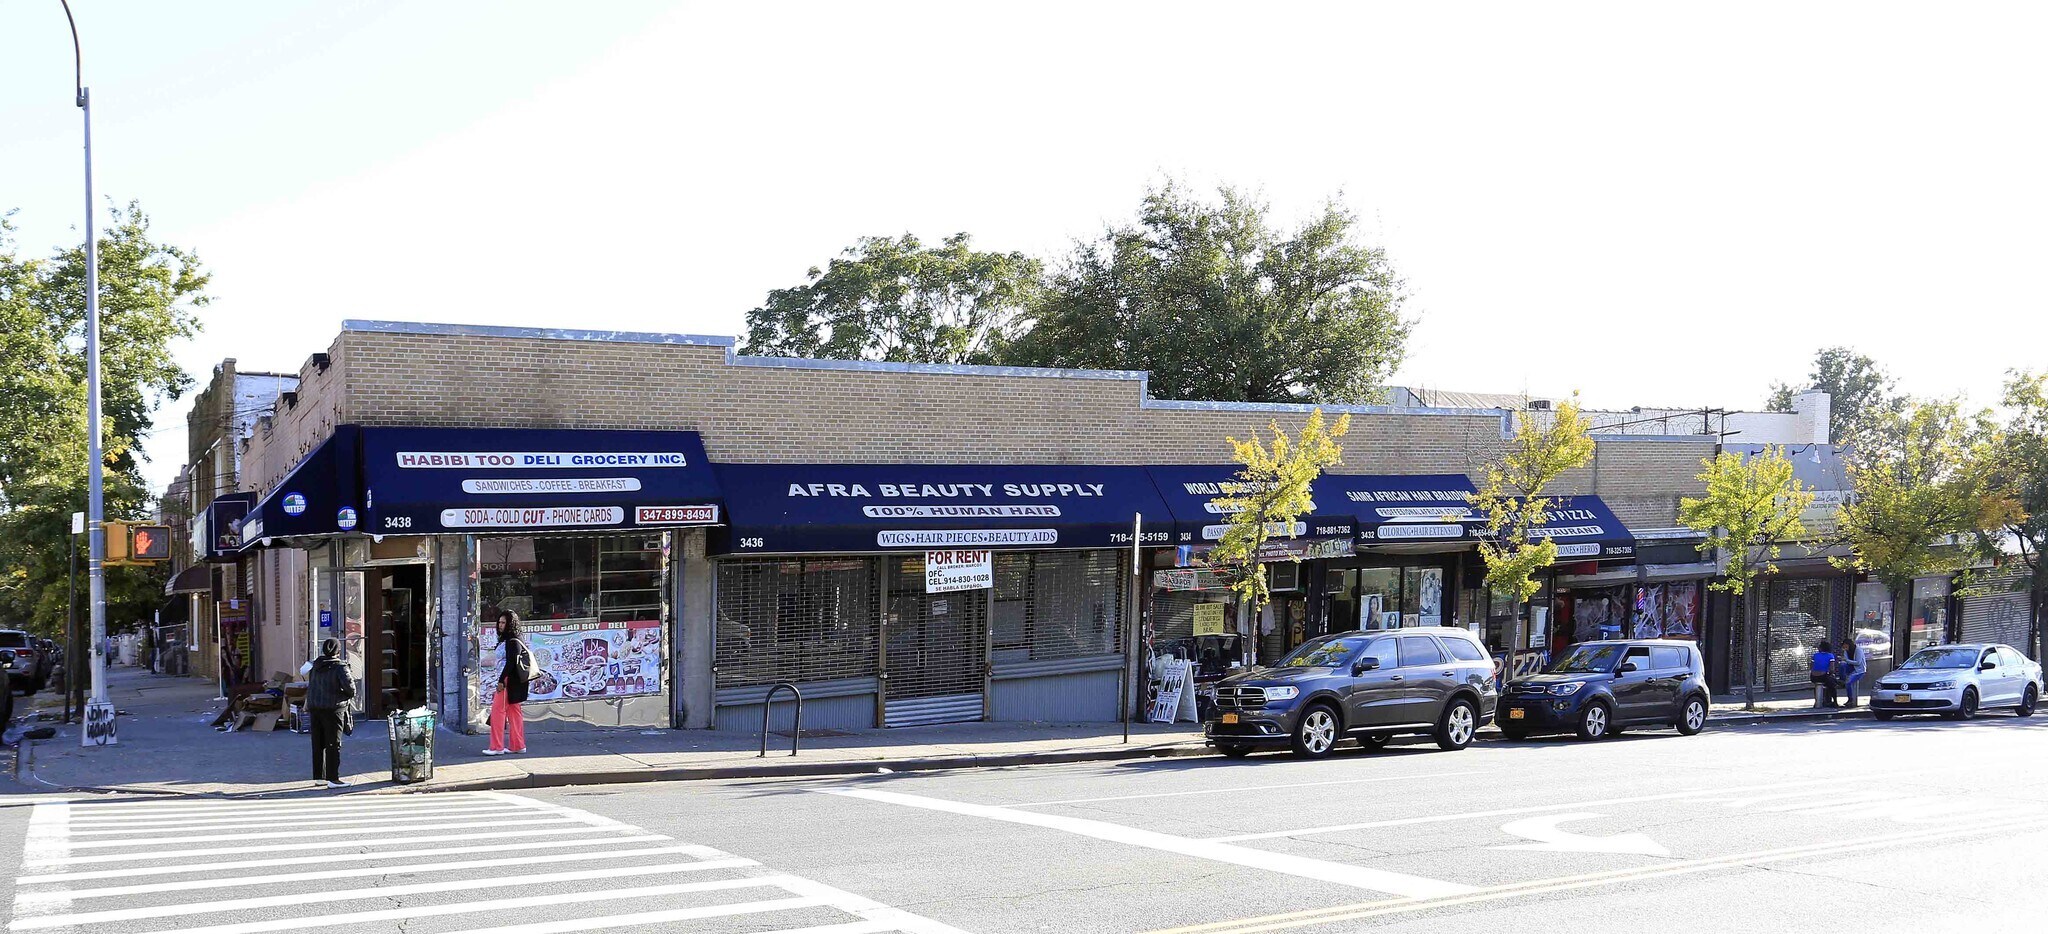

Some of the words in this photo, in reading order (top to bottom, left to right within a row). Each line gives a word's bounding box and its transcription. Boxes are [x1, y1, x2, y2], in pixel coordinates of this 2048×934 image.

[402, 455, 470, 466] HABIBI
[475, 455, 515, 466] TOO
[524, 455, 560, 465] DELI
[572, 455, 650, 465] GROCERY
[654, 455, 685, 465] INC.
[475, 481, 532, 491] SANDWICHES
[539, 481, 573, 491] COFFEE
[579, 480, 627, 490] BREAKFAST
[788, 483, 872, 497] AFRA
[879, 484, 993, 497] BEAUTY
[1003, 483, 1104, 497] SUPPLY
[1183, 482, 1218, 494] WORLD
[1346, 491, 1375, 501] SAMB
[1373, 491, 1412, 501] AFRICAN
[1410, 490, 1433, 501] HAIR
[465, 510, 489, 524] SODA
[496, 510, 520, 524] COLD
[523, 510, 546, 525] CUT
[552, 509, 582, 523] PHONE
[584, 508, 612, 523] CARDS
[643, 509, 712, 521] 347-899-8494
[869, 507, 924, 516] 100%
[930, 507, 1003, 516] HUMAN
[1010, 507, 1056, 516] HAIR
[1557, 509, 1598, 521] PIZZA
[385, 517, 411, 528] 3438
[1032, 531, 1056, 541] AIDS
[1180, 532, 1191, 541] 3434
[1361, 531, 1375, 539] 3432
[1429, 525, 1463, 537] EXTENSION
[1528, 525, 1599, 537] ESTAURANT
[740, 537, 763, 548] 3436
[1110, 532, 1168, 542] 718-45-5159
[928, 551, 952, 565] FOR
[956, 550, 989, 564] RENT
[928, 570, 945, 578] OFC.
[321, 613, 330, 622] EBT
[521, 625, 553, 633] BRONX
[582, 623, 600, 631] BOY
